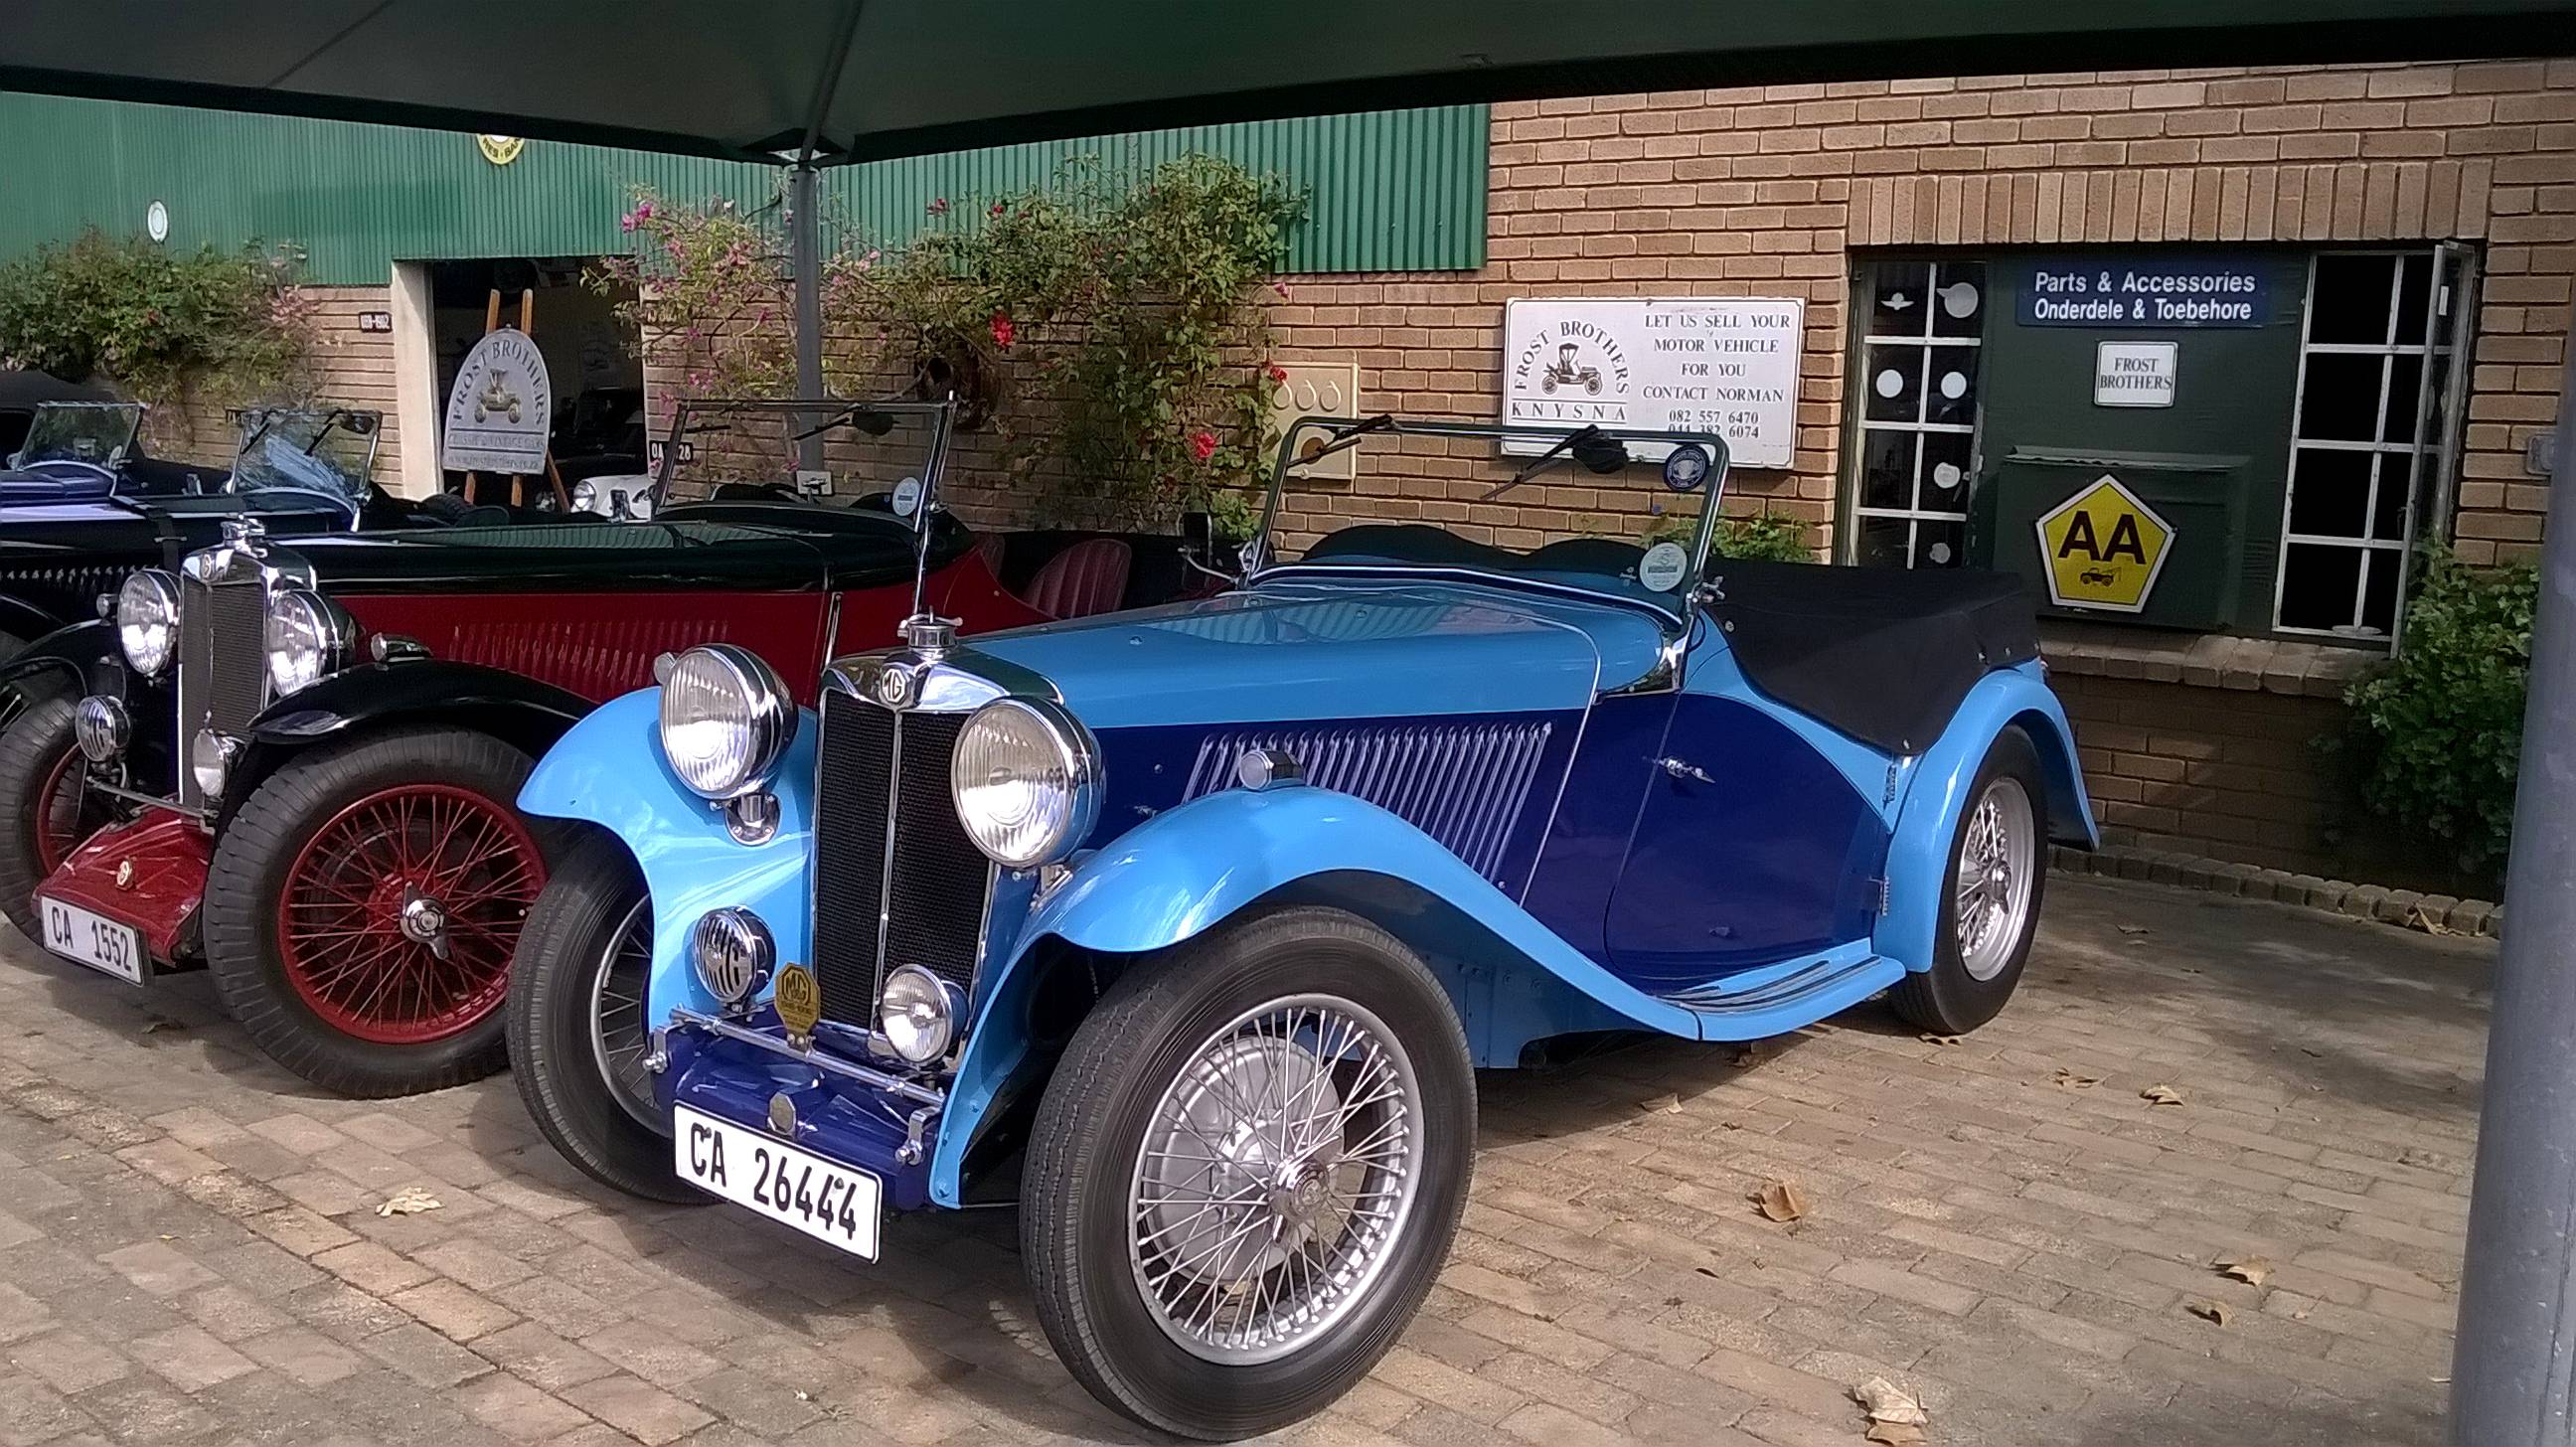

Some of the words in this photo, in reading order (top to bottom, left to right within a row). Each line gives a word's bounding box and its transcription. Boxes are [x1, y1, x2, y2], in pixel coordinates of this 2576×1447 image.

[2035, 271, 2086, 292] Parts
[2098, 271, 2112, 292] &
[2121, 270, 2256, 292] Accessories
[2035, 298, 2124, 320] Onderdele
[2133, 298, 2146, 320] &
[2154, 298, 2252, 320] Toebehore
[1645, 315, 1672, 328] LET
[1680, 315, 1697, 328] US
[1704, 315, 1741, 328] SELL
[1751, 315, 1790, 328] YOUR
[1654, 339, 1705, 352] MOTOR
[1714, 339, 1779, 353] VEHICLE
[1515, 329, 1550, 391] FROST
[1559, 320, 1630, 395] BROTHERS
[2114, 357, 2160, 373] FROST
[1682, 363, 1709, 376] FOR
[1718, 364, 1746, 377] YOU
[453, 349, 487, 420] FROST
[2099, 375, 2174, 391] BROTHERS
[1643, 386, 1708, 400] CONTACT
[1717, 388, 1784, 402] NORMAN
[1512, 402, 1626, 420] KNYSNA
[1669, 410, 1691, 422] 082
[1698, 410, 1721, 423] 557
[1728, 411, 1759, 424] 6470
[1728, 425, 1759, 438] 6074
[2058, 511, 2147, 565] AA
[883, 670, 903, 700] MG
[52, 906, 74, 949] CA
[91, 920, 132, 973] 1552
[691, 1122, 727, 1188] CA
[753, 1148, 858, 1241] 26444
